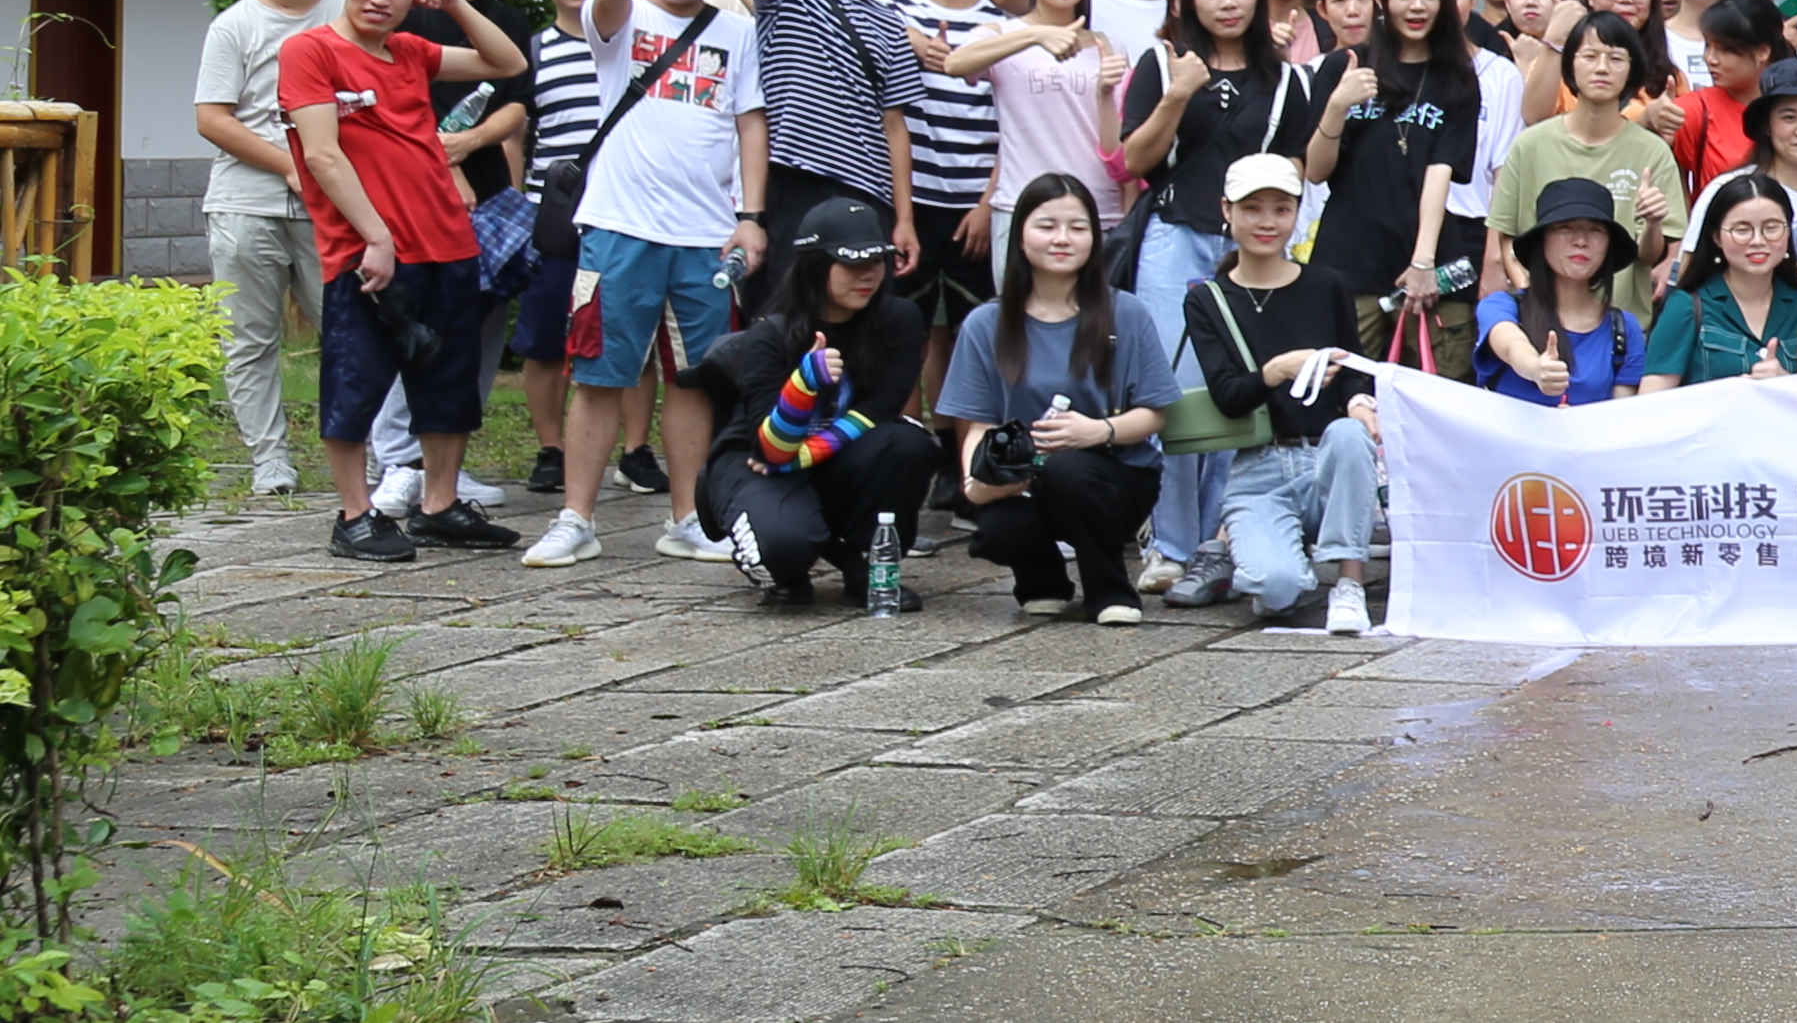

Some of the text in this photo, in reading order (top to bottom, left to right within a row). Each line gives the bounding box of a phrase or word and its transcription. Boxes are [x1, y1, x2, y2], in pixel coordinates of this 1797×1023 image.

[1600, 482, 1778, 523] 环金科技
[1602, 524, 1778, 542] UEB TECHNOLOGY
[1605, 542, 1779, 569] 跨境新零售
